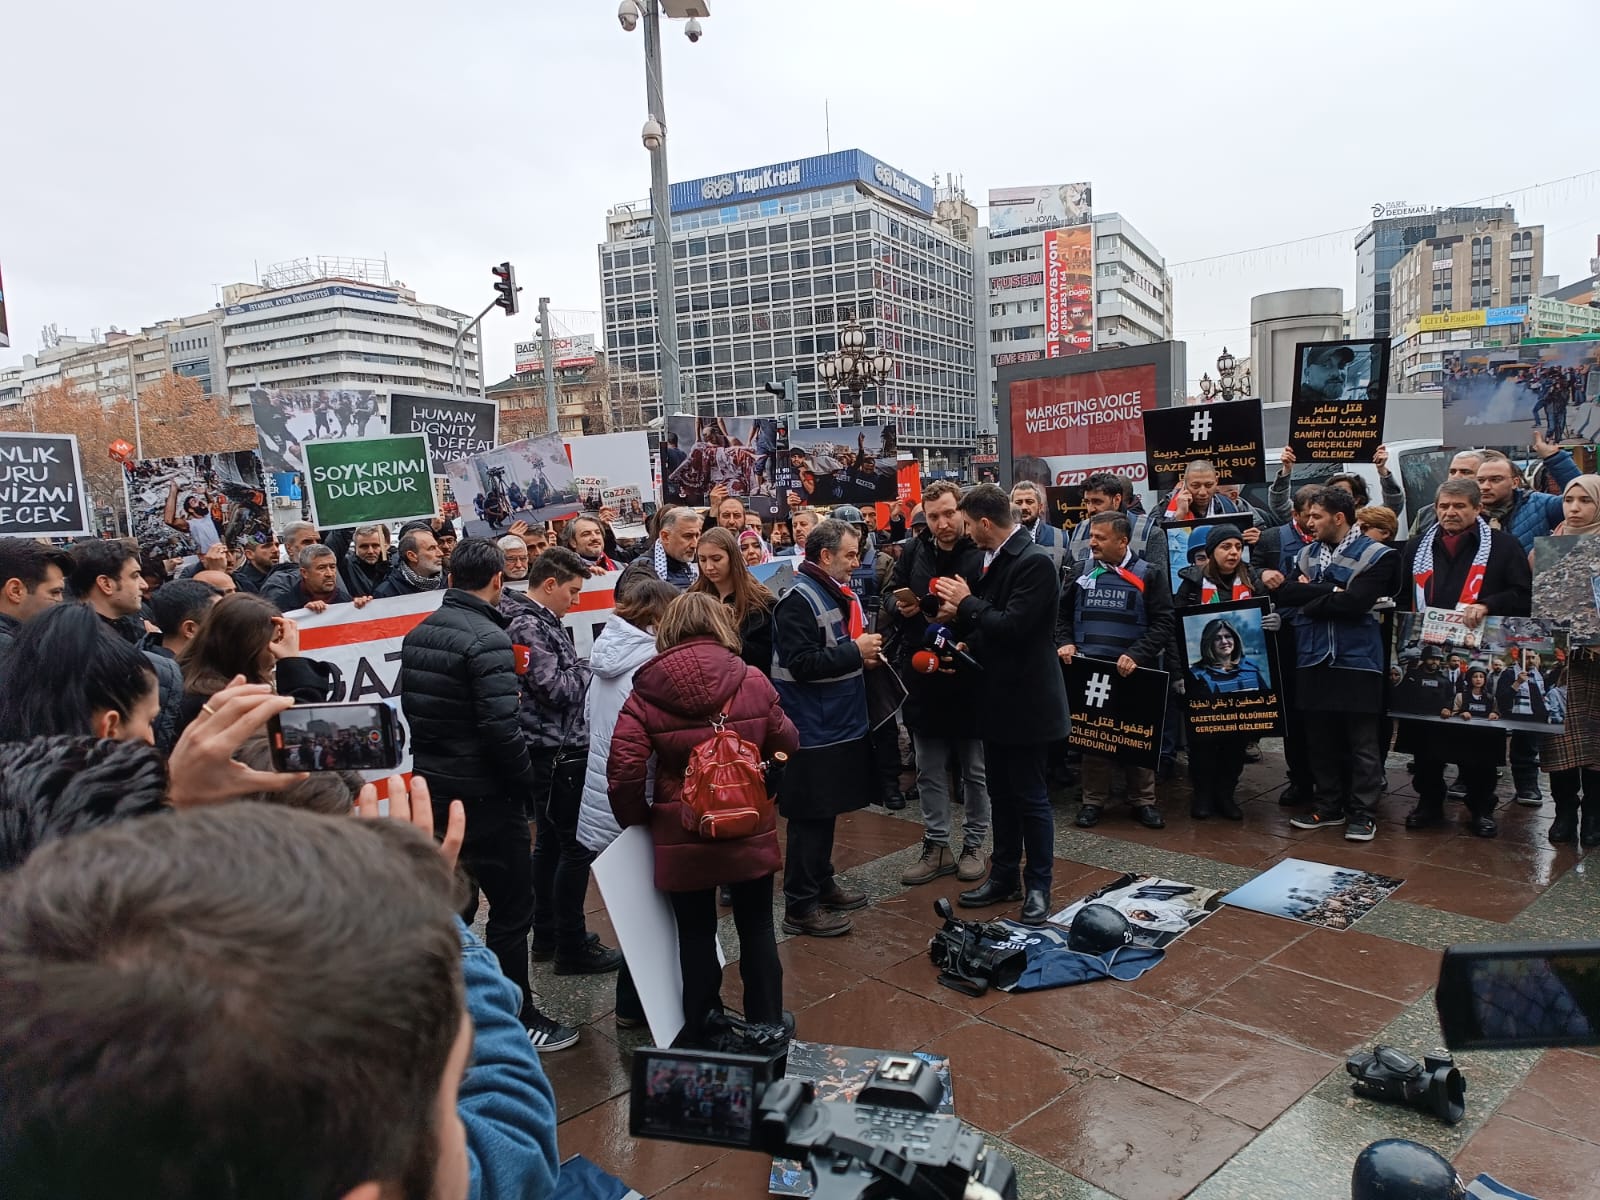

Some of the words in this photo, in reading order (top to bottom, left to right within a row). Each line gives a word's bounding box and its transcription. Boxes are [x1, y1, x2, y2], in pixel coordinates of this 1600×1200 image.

[1048, 240, 1062, 342] Rezervasyon
[1025, 398, 1097, 421] MARKETING
[1099, 390, 1141, 409] VOICE
[1313, 404, 1338, 415] سامر
[1340, 403, 1363, 415] قتل
[412, 406, 476, 423] HUMAN
[1025, 405, 1142, 434] WELKOMSTBONUS
[1297, 415, 1337, 427] الحقيقة
[410, 420, 476, 437] DIGNITY
[1327, 429, 1377, 439] ÖLDÜRMEK
[438, 436, 494, 451] DEFEAT
[1306, 440, 1362, 449] GERÇEKLERİ
[429, 449, 475, 461] ONISM
[1311, 449, 1355, 459] GİZLEMEZ
[1231, 457, 1257, 468] SUÇ
[313, 458, 425, 482] SOYKIRIMI
[327, 477, 418, 499] DURDUR
[1088, 589, 1126, 599] BASIN
[1087, 599, 1125, 608] PRESS
[1190, 712, 1238, 723] GAZETECİLERİ
[1239, 710, 1279, 720] ÖLDÜRMEK
[1195, 723, 1237, 734] GERÇEKLERİ
[1239, 721, 1274, 731] GİZLEMEZ
[1068, 735, 1117, 753] DURDURUN
[1071, 726, 1098, 739] CİLERİ
[1100, 731, 1152, 751] ÖLDÜRMEYİ
